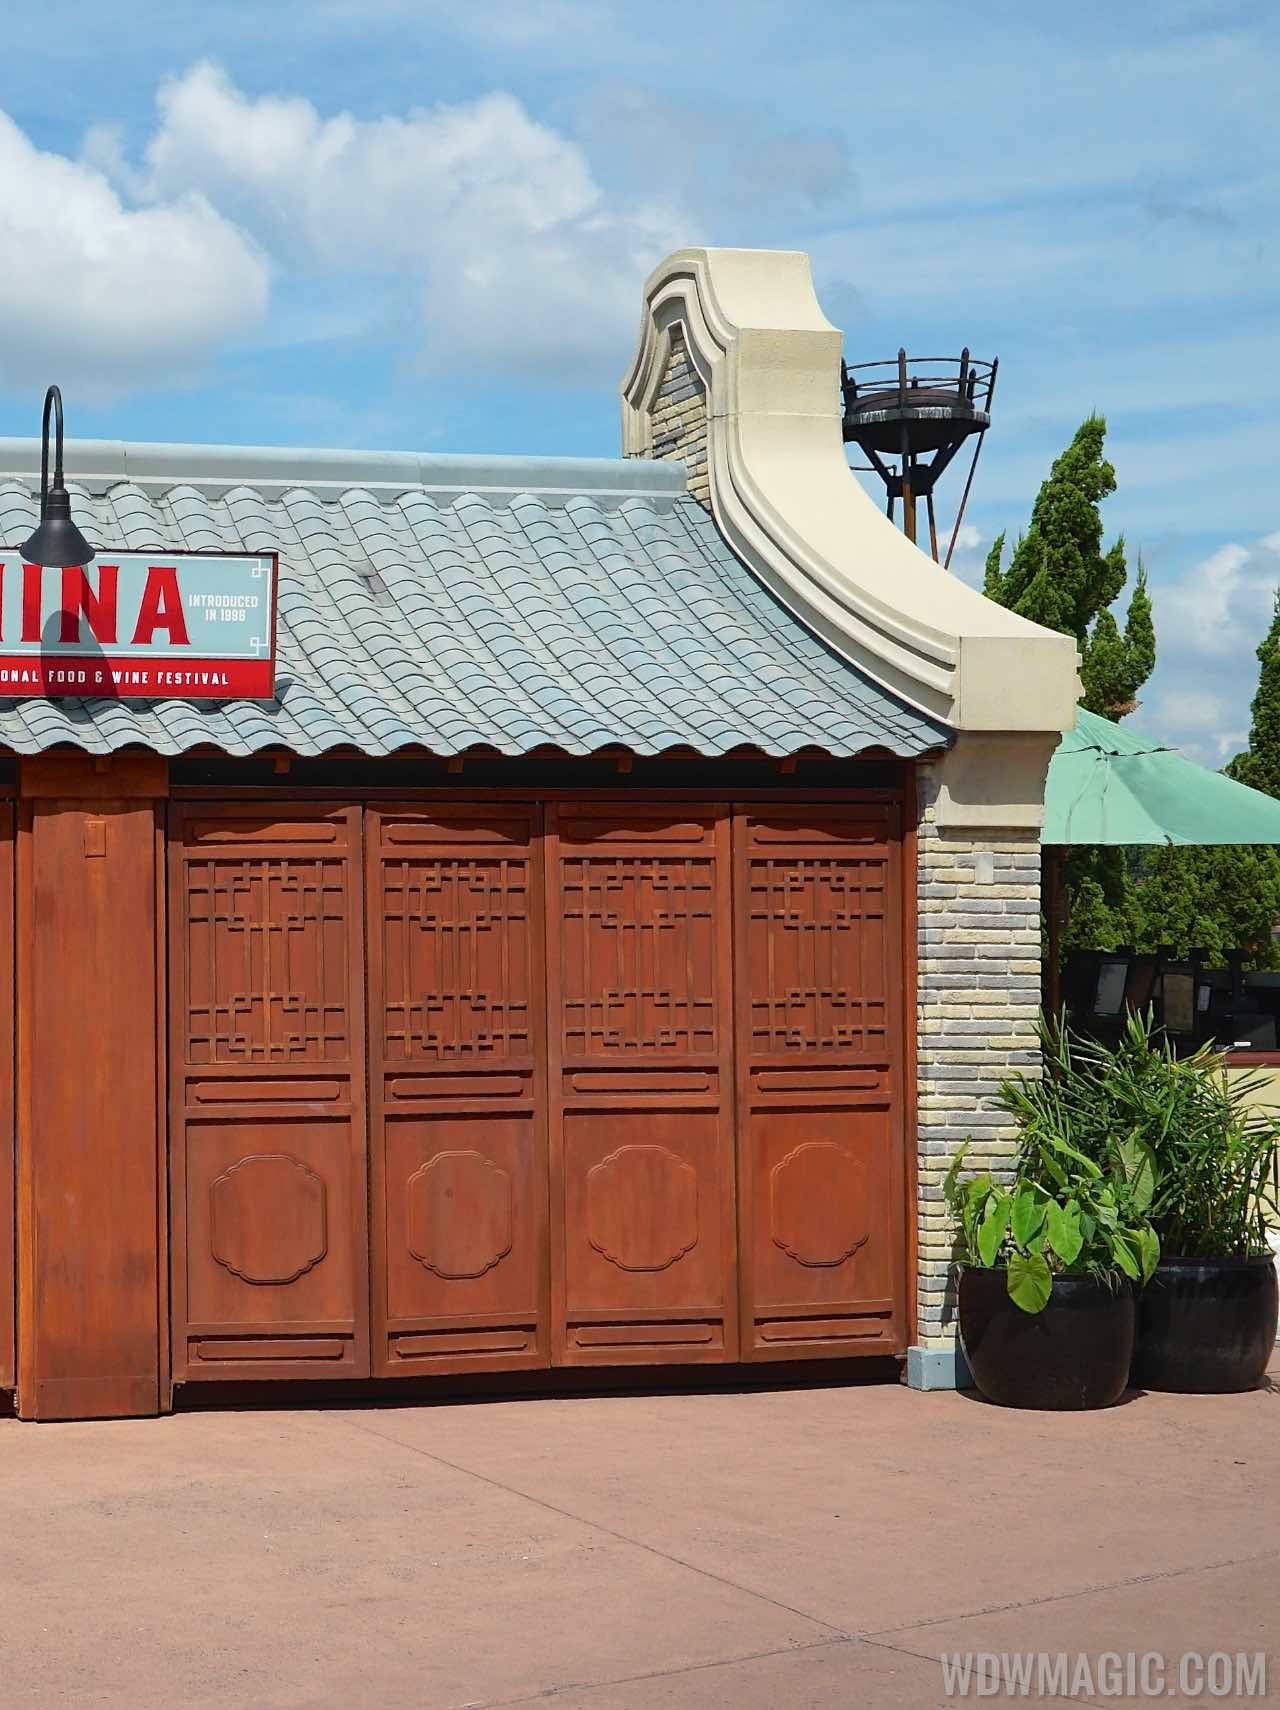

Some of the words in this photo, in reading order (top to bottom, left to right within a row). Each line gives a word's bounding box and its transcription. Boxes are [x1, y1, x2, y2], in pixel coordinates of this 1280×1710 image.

[188, 594, 259, 608] INTRODUCED
[205, 609, 217, 622] IN
[48, 670, 86, 683] FOOD
[95, 671, 103, 683] &
[112, 671, 149, 684] WINE
[157, 672, 229, 685] FESTIVAL
